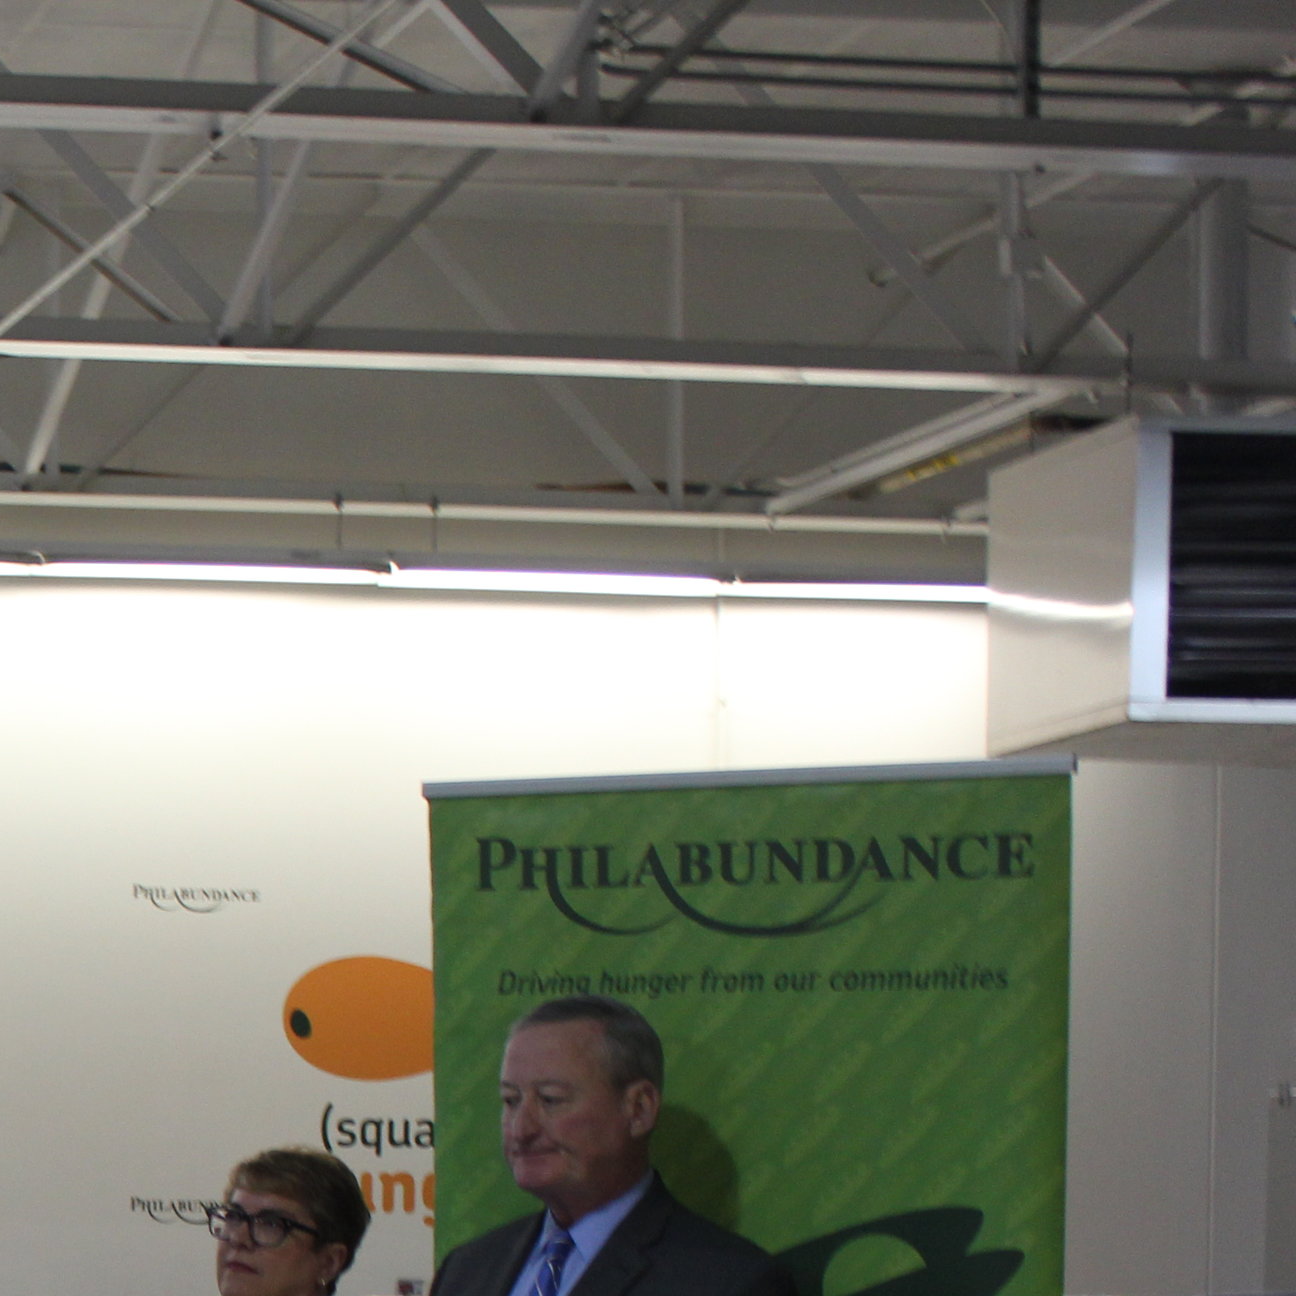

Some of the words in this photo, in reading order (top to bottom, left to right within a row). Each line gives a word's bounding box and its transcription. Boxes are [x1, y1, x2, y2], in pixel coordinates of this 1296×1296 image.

[476, 831, 1035, 937] PHILABUNDANCE
[498, 968, 592, 997] Driving
[599, 970, 694, 999] hunger
[699, 965, 766, 994] from
[774, 970, 821, 994] our
[828, 962, 1009, 992] communities
[321, 1102, 435, 1157] (squa
